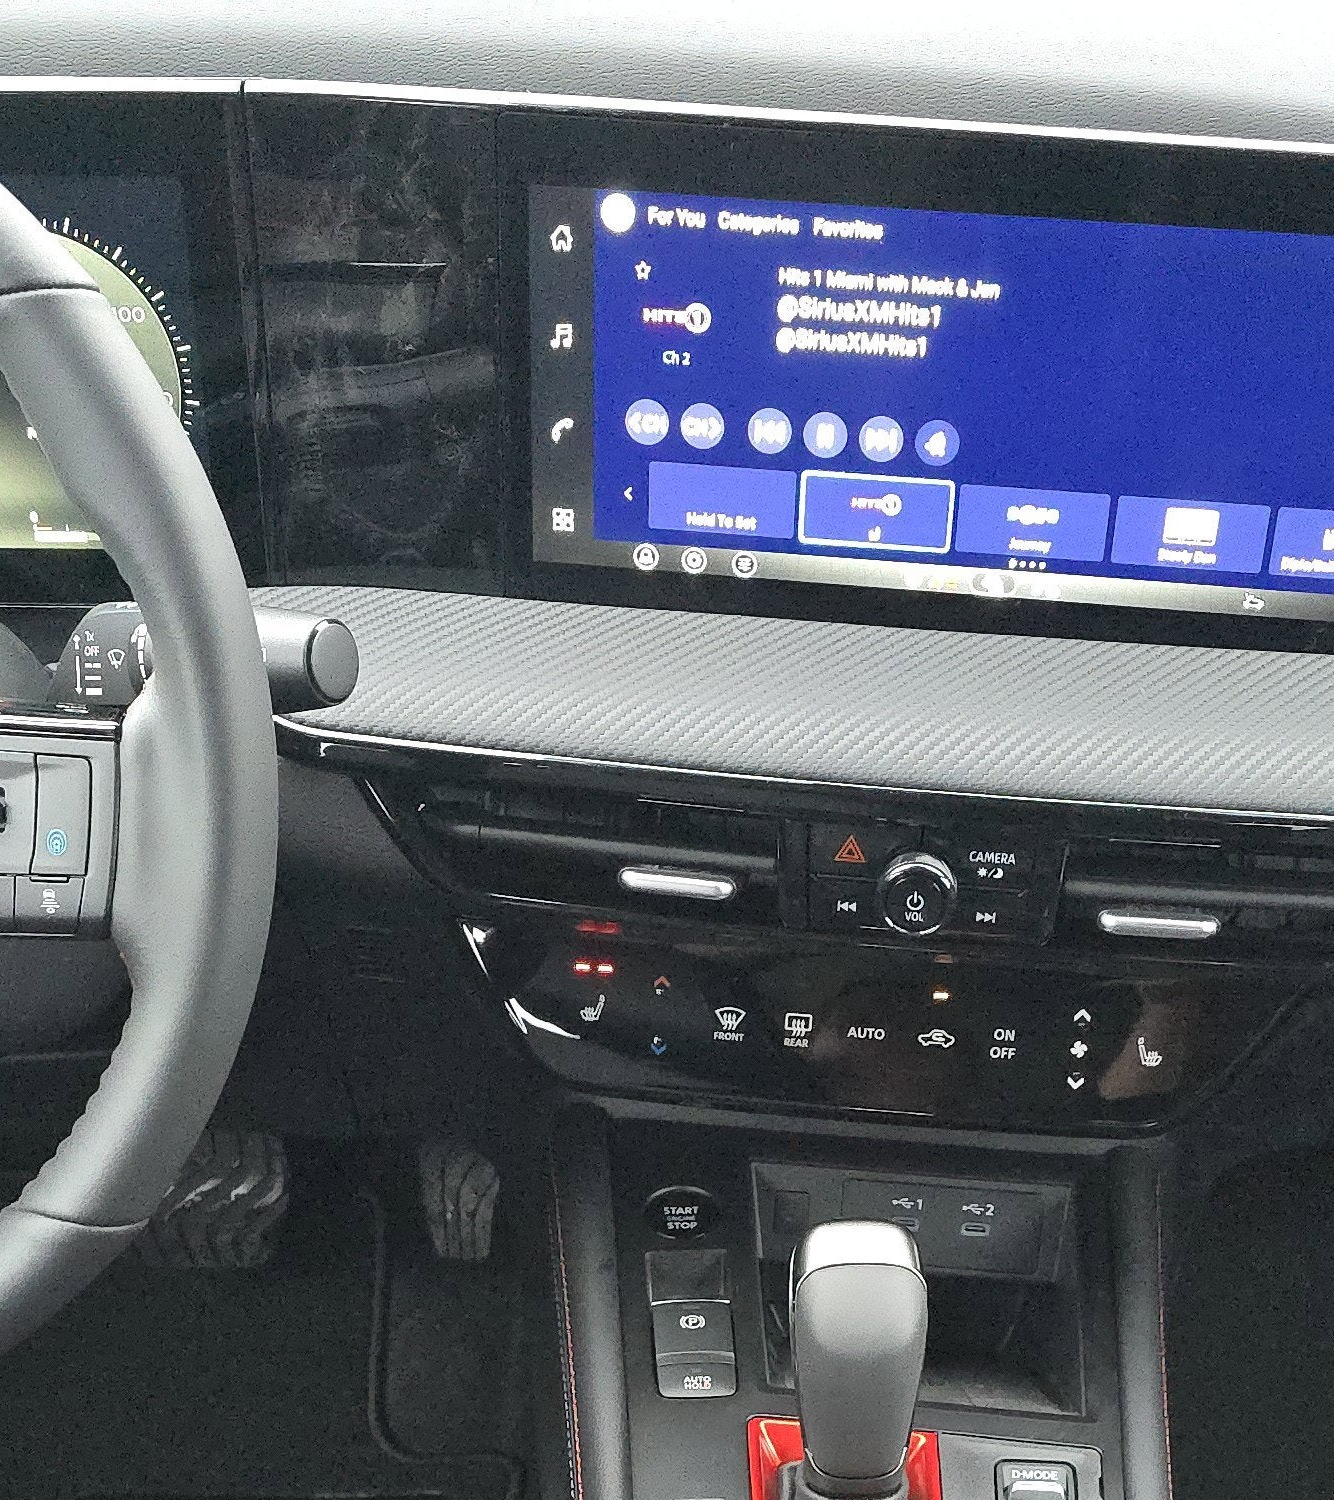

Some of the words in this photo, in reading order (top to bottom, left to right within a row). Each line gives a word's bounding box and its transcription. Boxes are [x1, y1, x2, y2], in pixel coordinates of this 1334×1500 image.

[647, 204, 675, 227] For
[675, 206, 707, 230] You
[717, 210, 800, 236] Categories
[812, 215, 885, 241] Favorites
[876, 273, 909, 294] with
[662, 350, 680, 366] Ch
[682, 351, 691, 366] 2
[83, 645, 100, 657] OFF
[969, 850, 1016, 865] CAMERA
[904, 911, 924, 923] VOL
[713, 1031, 745, 1042] FRONT
[846, 1026, 886, 1041] AUTO
[993, 1028, 1016, 1042] ON
[783, 1037, 809, 1048] REAR
[989, 1046, 1017, 1060] OFF
[663, 1206, 699, 1215] START
[916, 1198, 923, 1211] 1
[985, 1203, 995, 1216] 2
[666, 1221, 698, 1230] STOP
[683, 1375, 712, 1383] AUTO
[683, 1382, 712, 1390] HOLD
[1011, 1469, 1060, 1480] D-MODE
